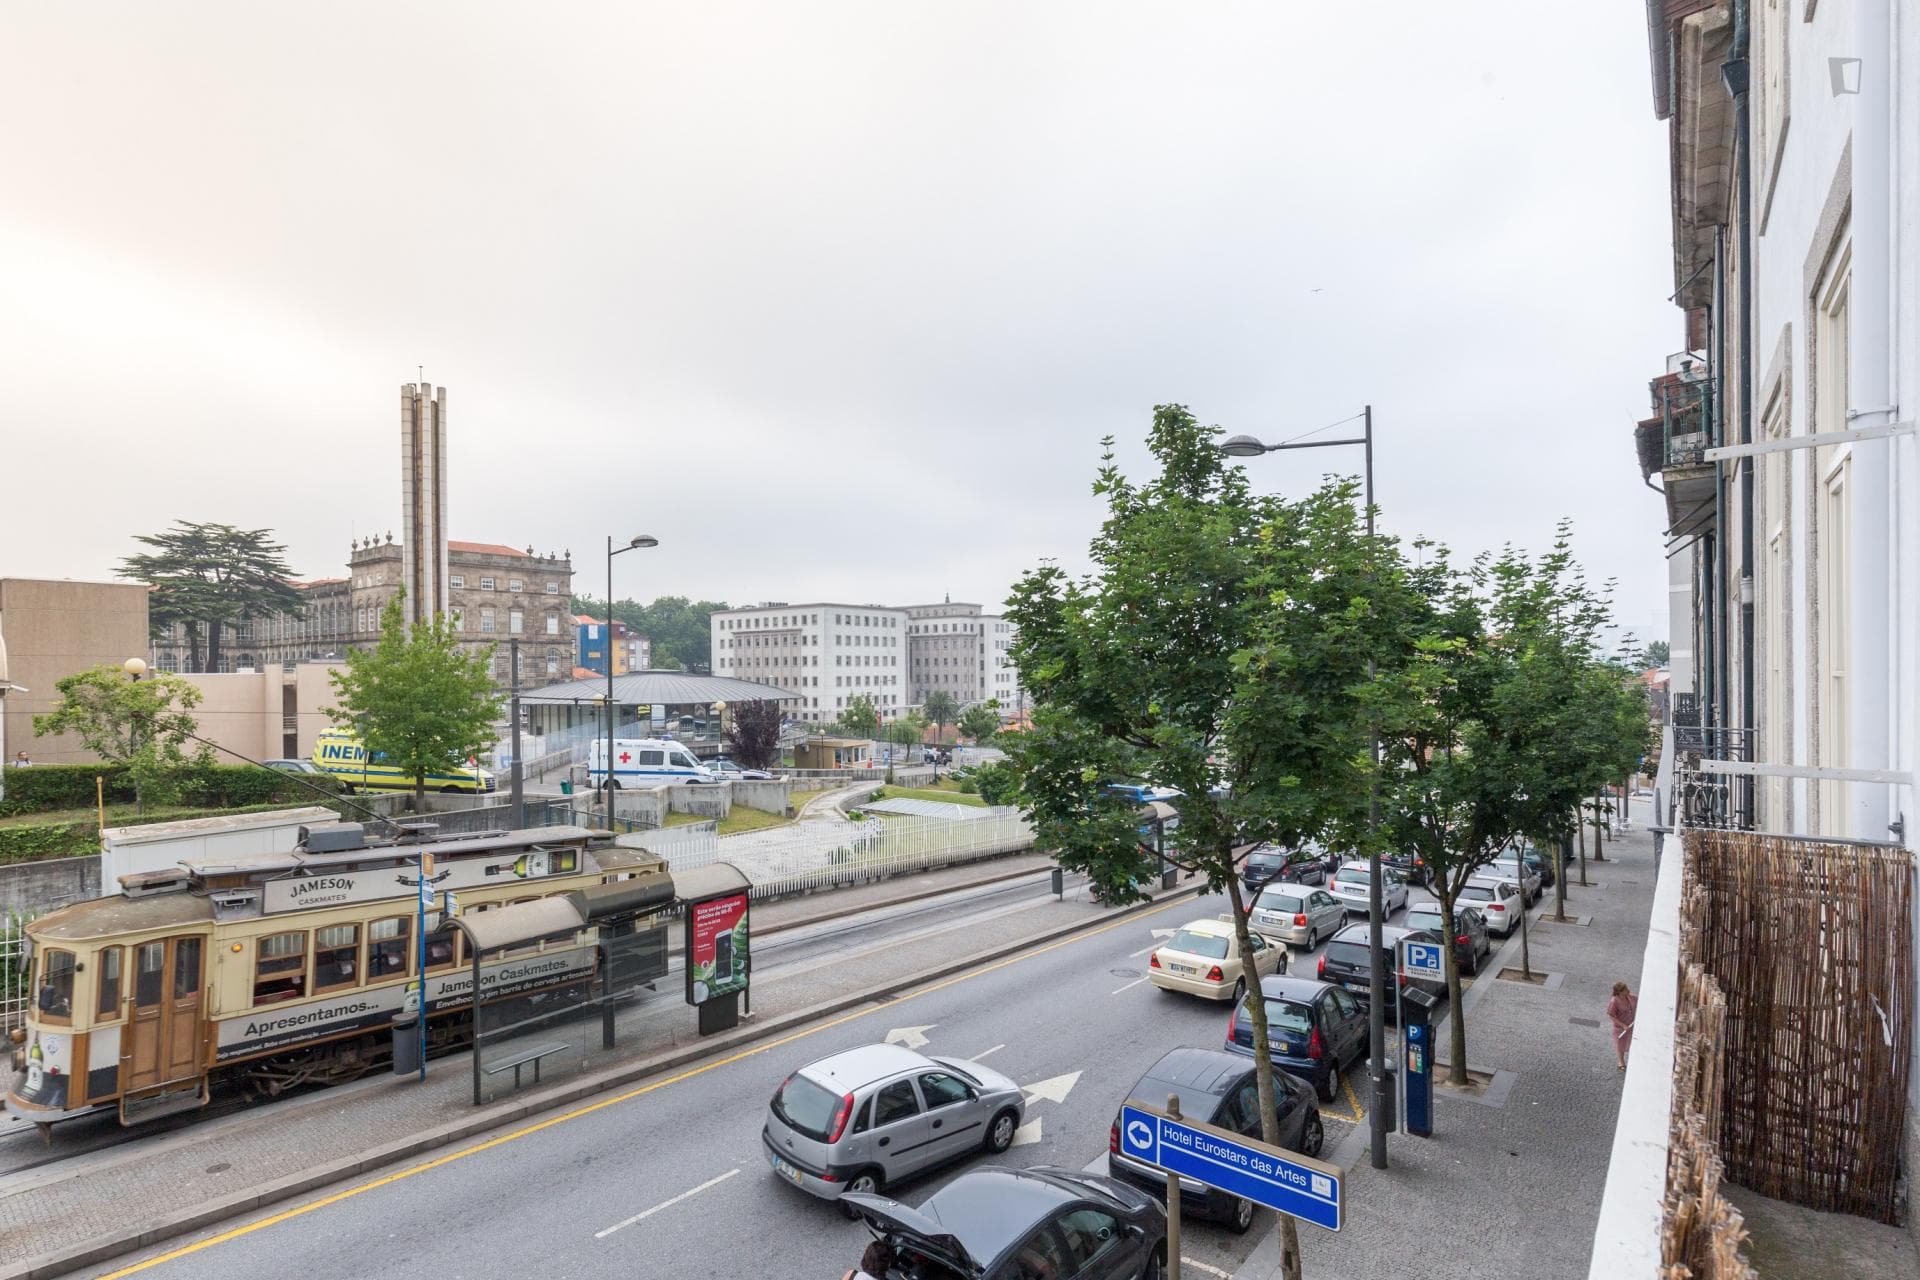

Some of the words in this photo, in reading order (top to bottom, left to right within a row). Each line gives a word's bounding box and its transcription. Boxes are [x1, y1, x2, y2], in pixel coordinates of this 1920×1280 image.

[321, 744, 369, 760] INEM
[290, 877, 356, 898] JAMESON
[298, 893, 347, 906] CASKMATES
[1411, 946, 1427, 966] P
[438, 973, 496, 995] Jameon
[500, 959, 569, 981] Caskmates.
[436, 991, 485, 1009] Envelheco
[244, 1000, 380, 1037] Apresentamos...
[1409, 1025, 1418, 1037] P
[1164, 1125, 1192, 1147] Hotel
[1195, 1136, 1248, 1166] Eurostars
[1250, 1156, 1272, 1175] das
[1275, 1164, 1307, 1187] Artes
